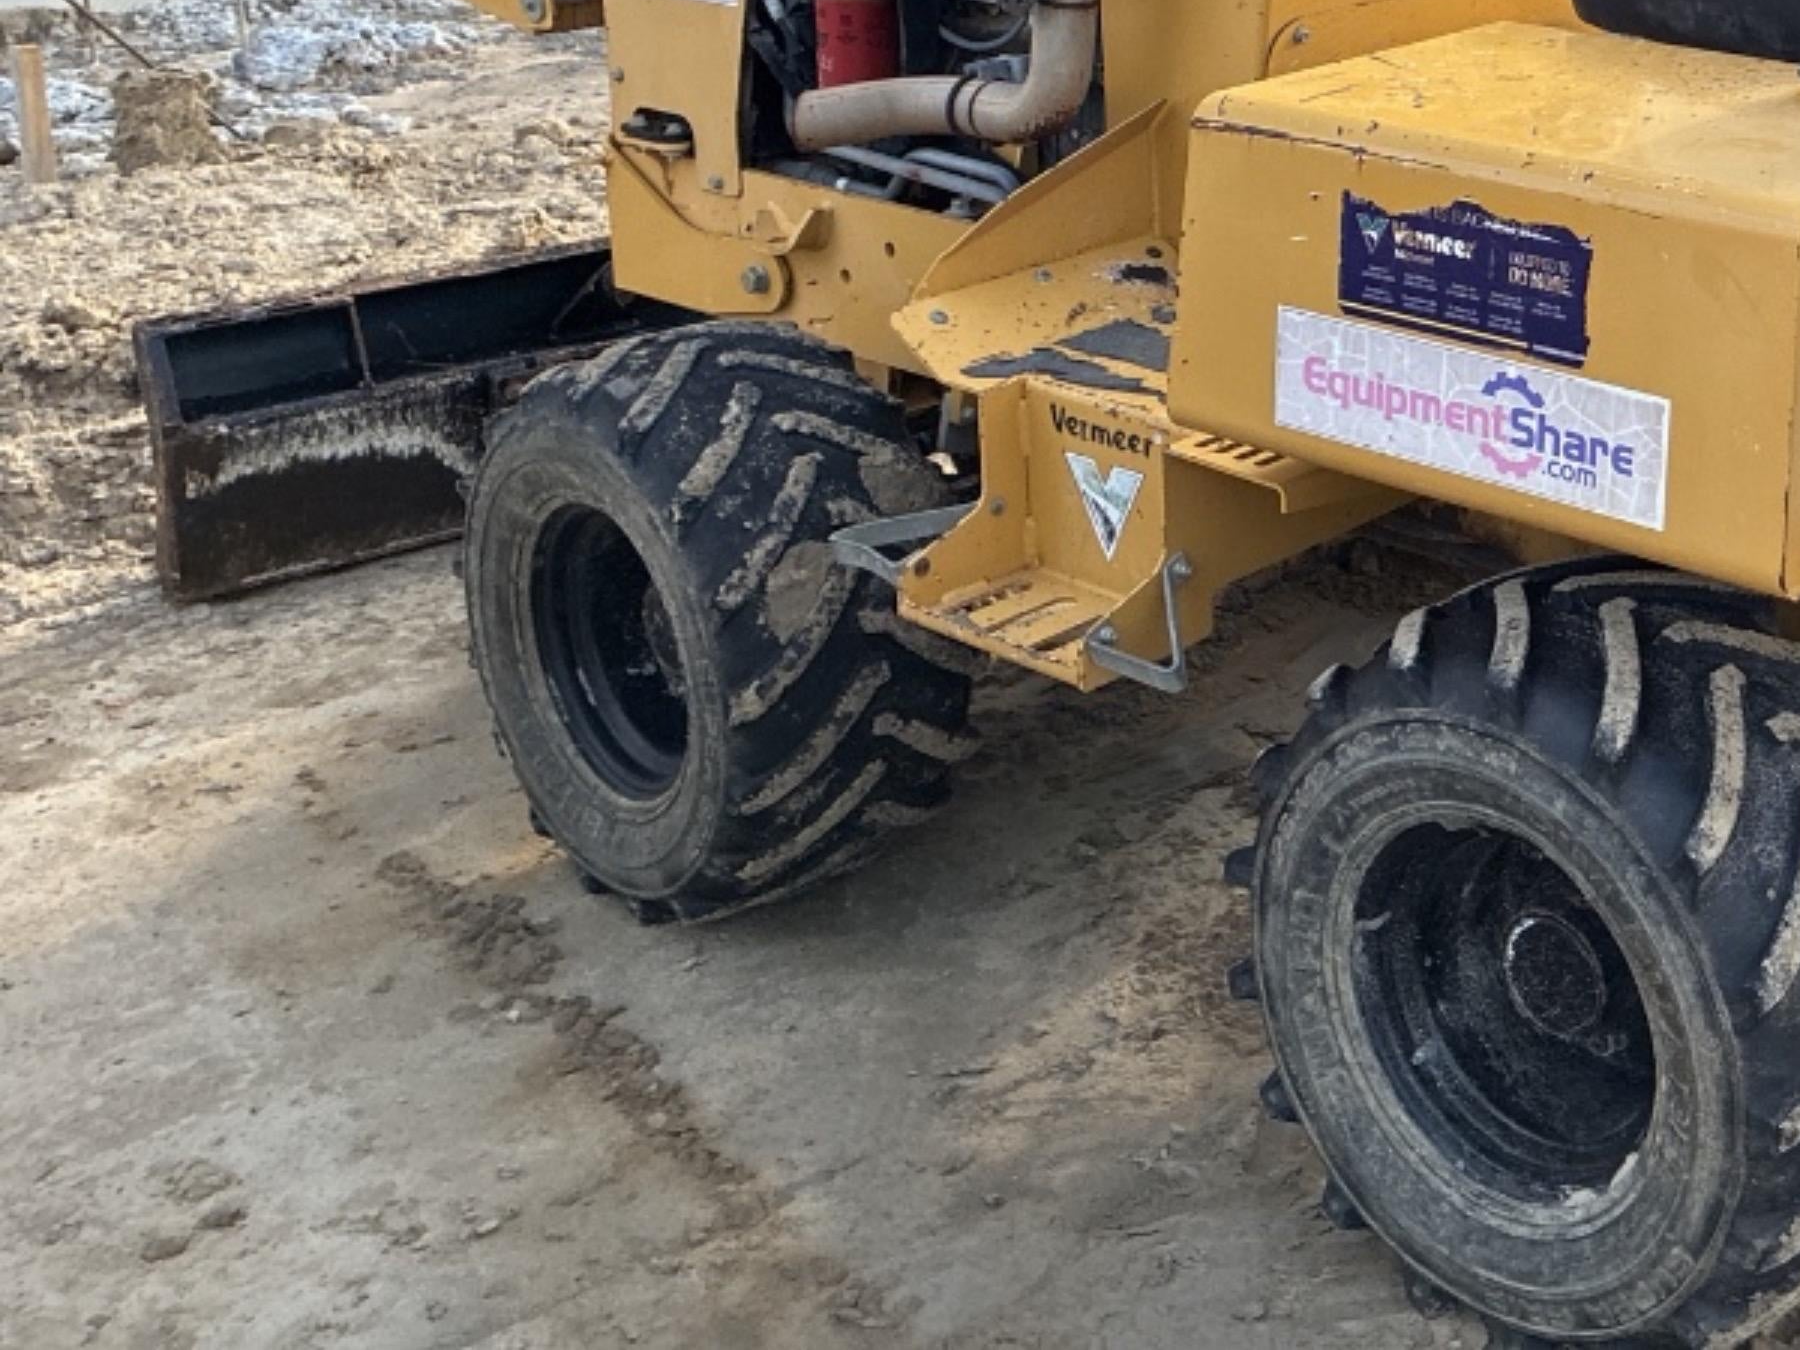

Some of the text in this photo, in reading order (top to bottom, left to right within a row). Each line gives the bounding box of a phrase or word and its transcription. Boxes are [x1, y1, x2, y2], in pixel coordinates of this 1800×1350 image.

[1049, 402, 1153, 458] Vermeer
[1303, 355, 1634, 477] EquipmentShare
[1541, 457, 1597, 488] .com
